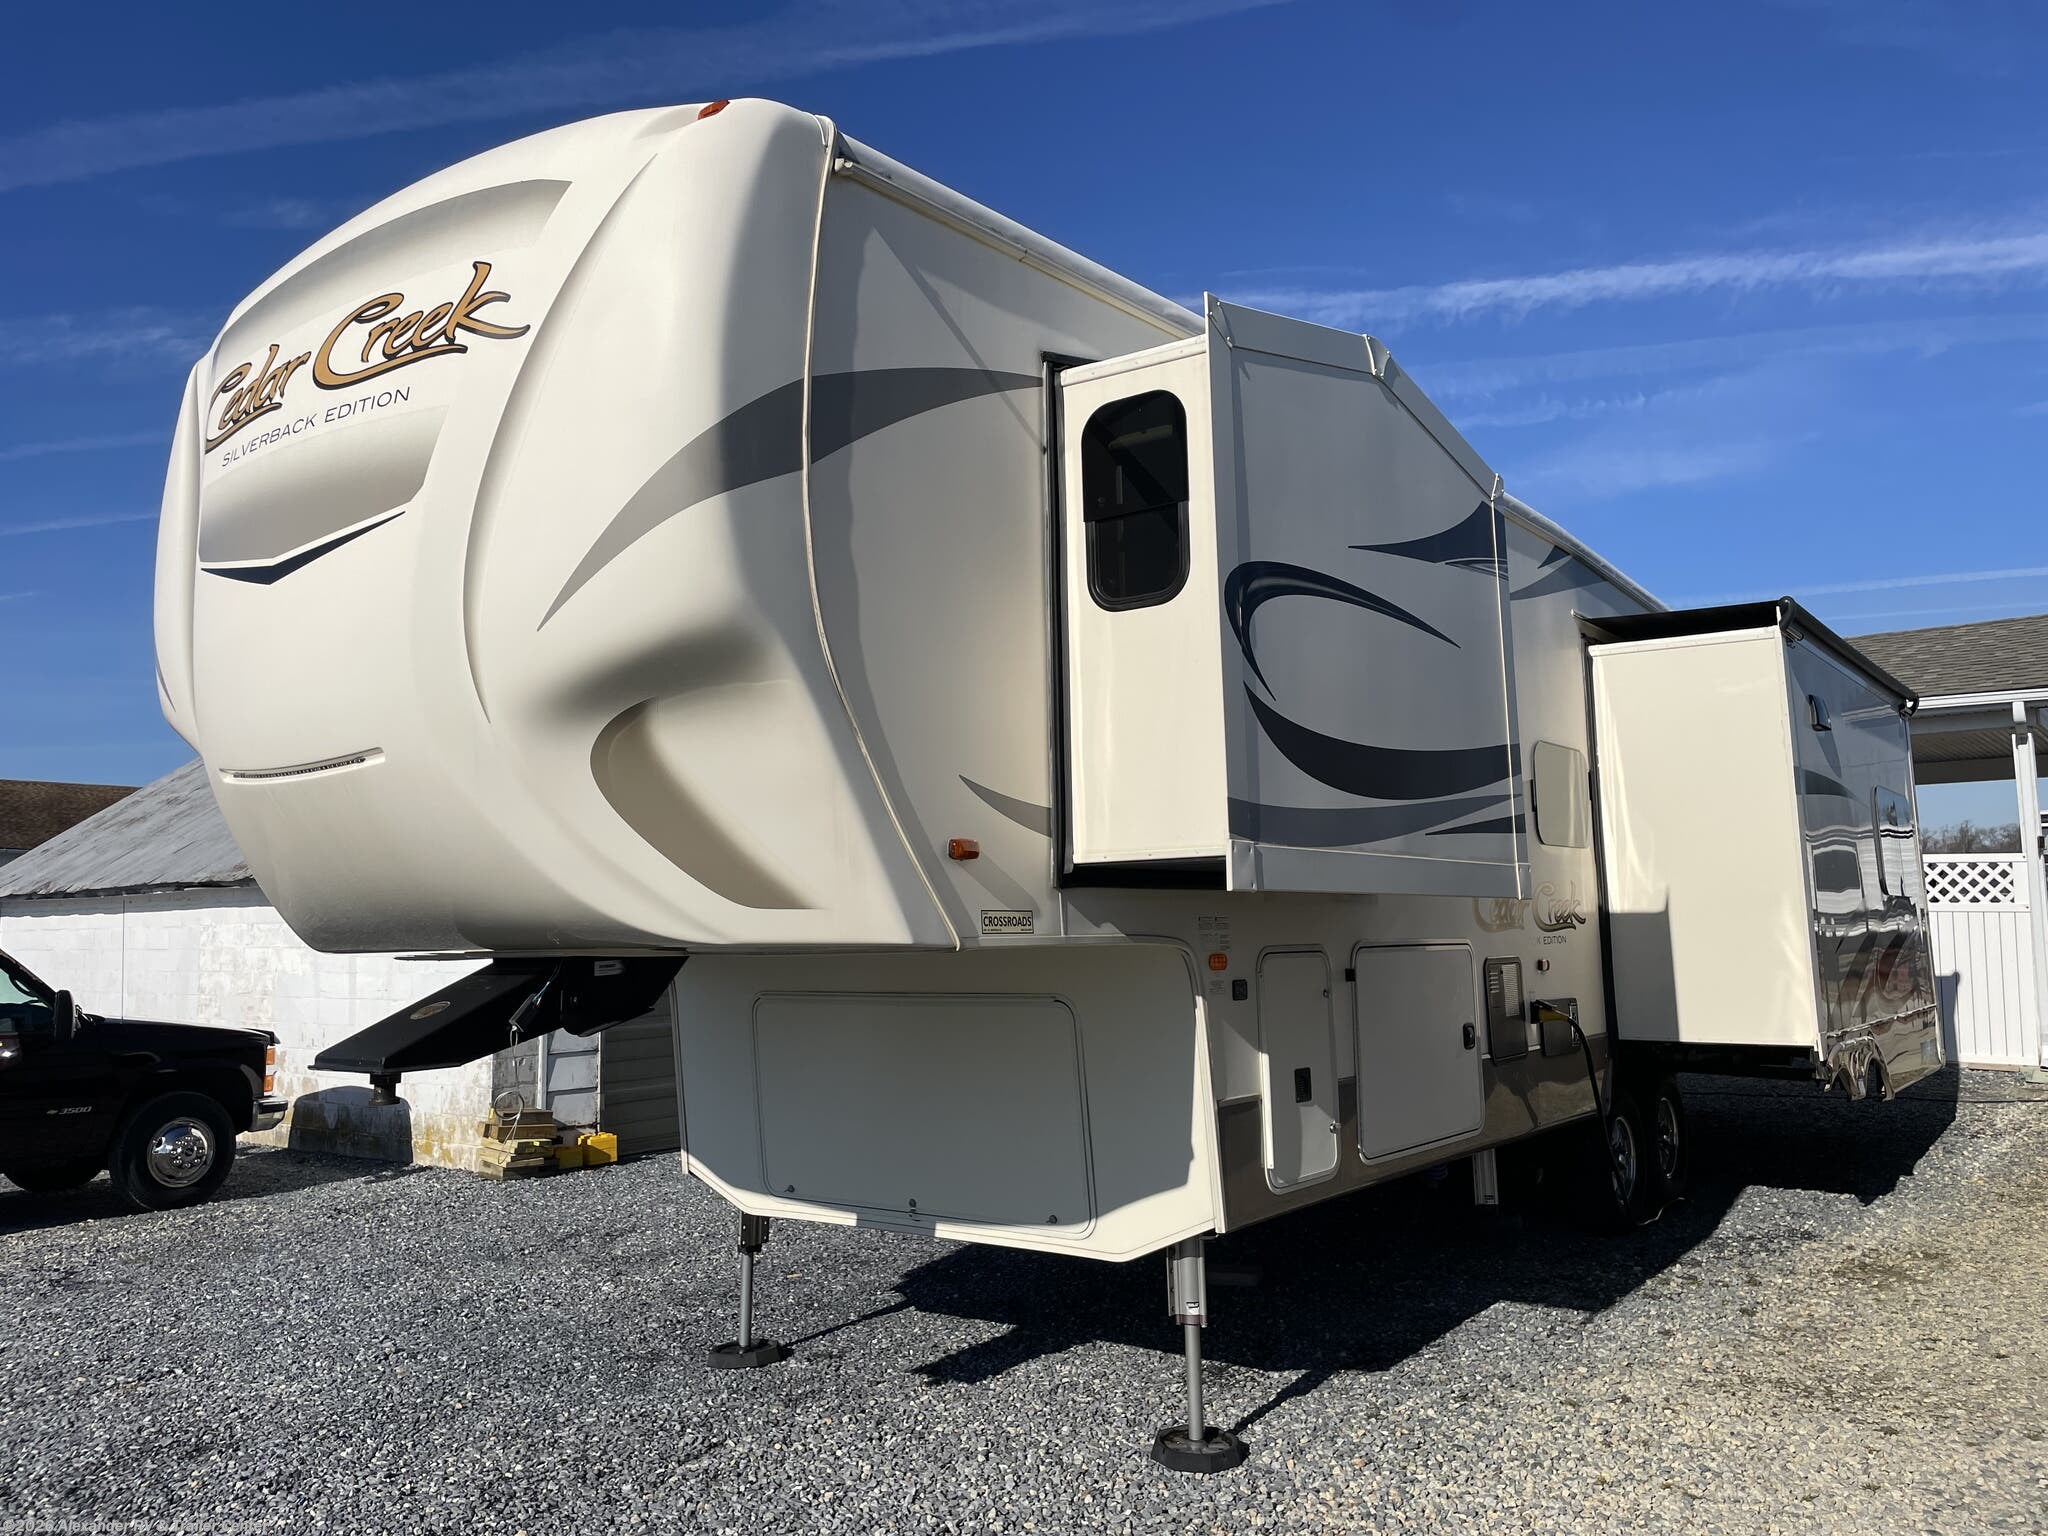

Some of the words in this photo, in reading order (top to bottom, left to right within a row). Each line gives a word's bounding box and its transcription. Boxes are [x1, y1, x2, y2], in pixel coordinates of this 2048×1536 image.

[205, 344, 311, 454] Cedar
[312, 261, 531, 390] Creek
[222, 413, 317, 468] SILVERBACK
[324, 386, 411, 424] EDITION
[983, 915, 1032, 927] CROSSROADS
[1532, 880, 1587, 932] Creek
[1543, 936, 1568, 946] EDITION
